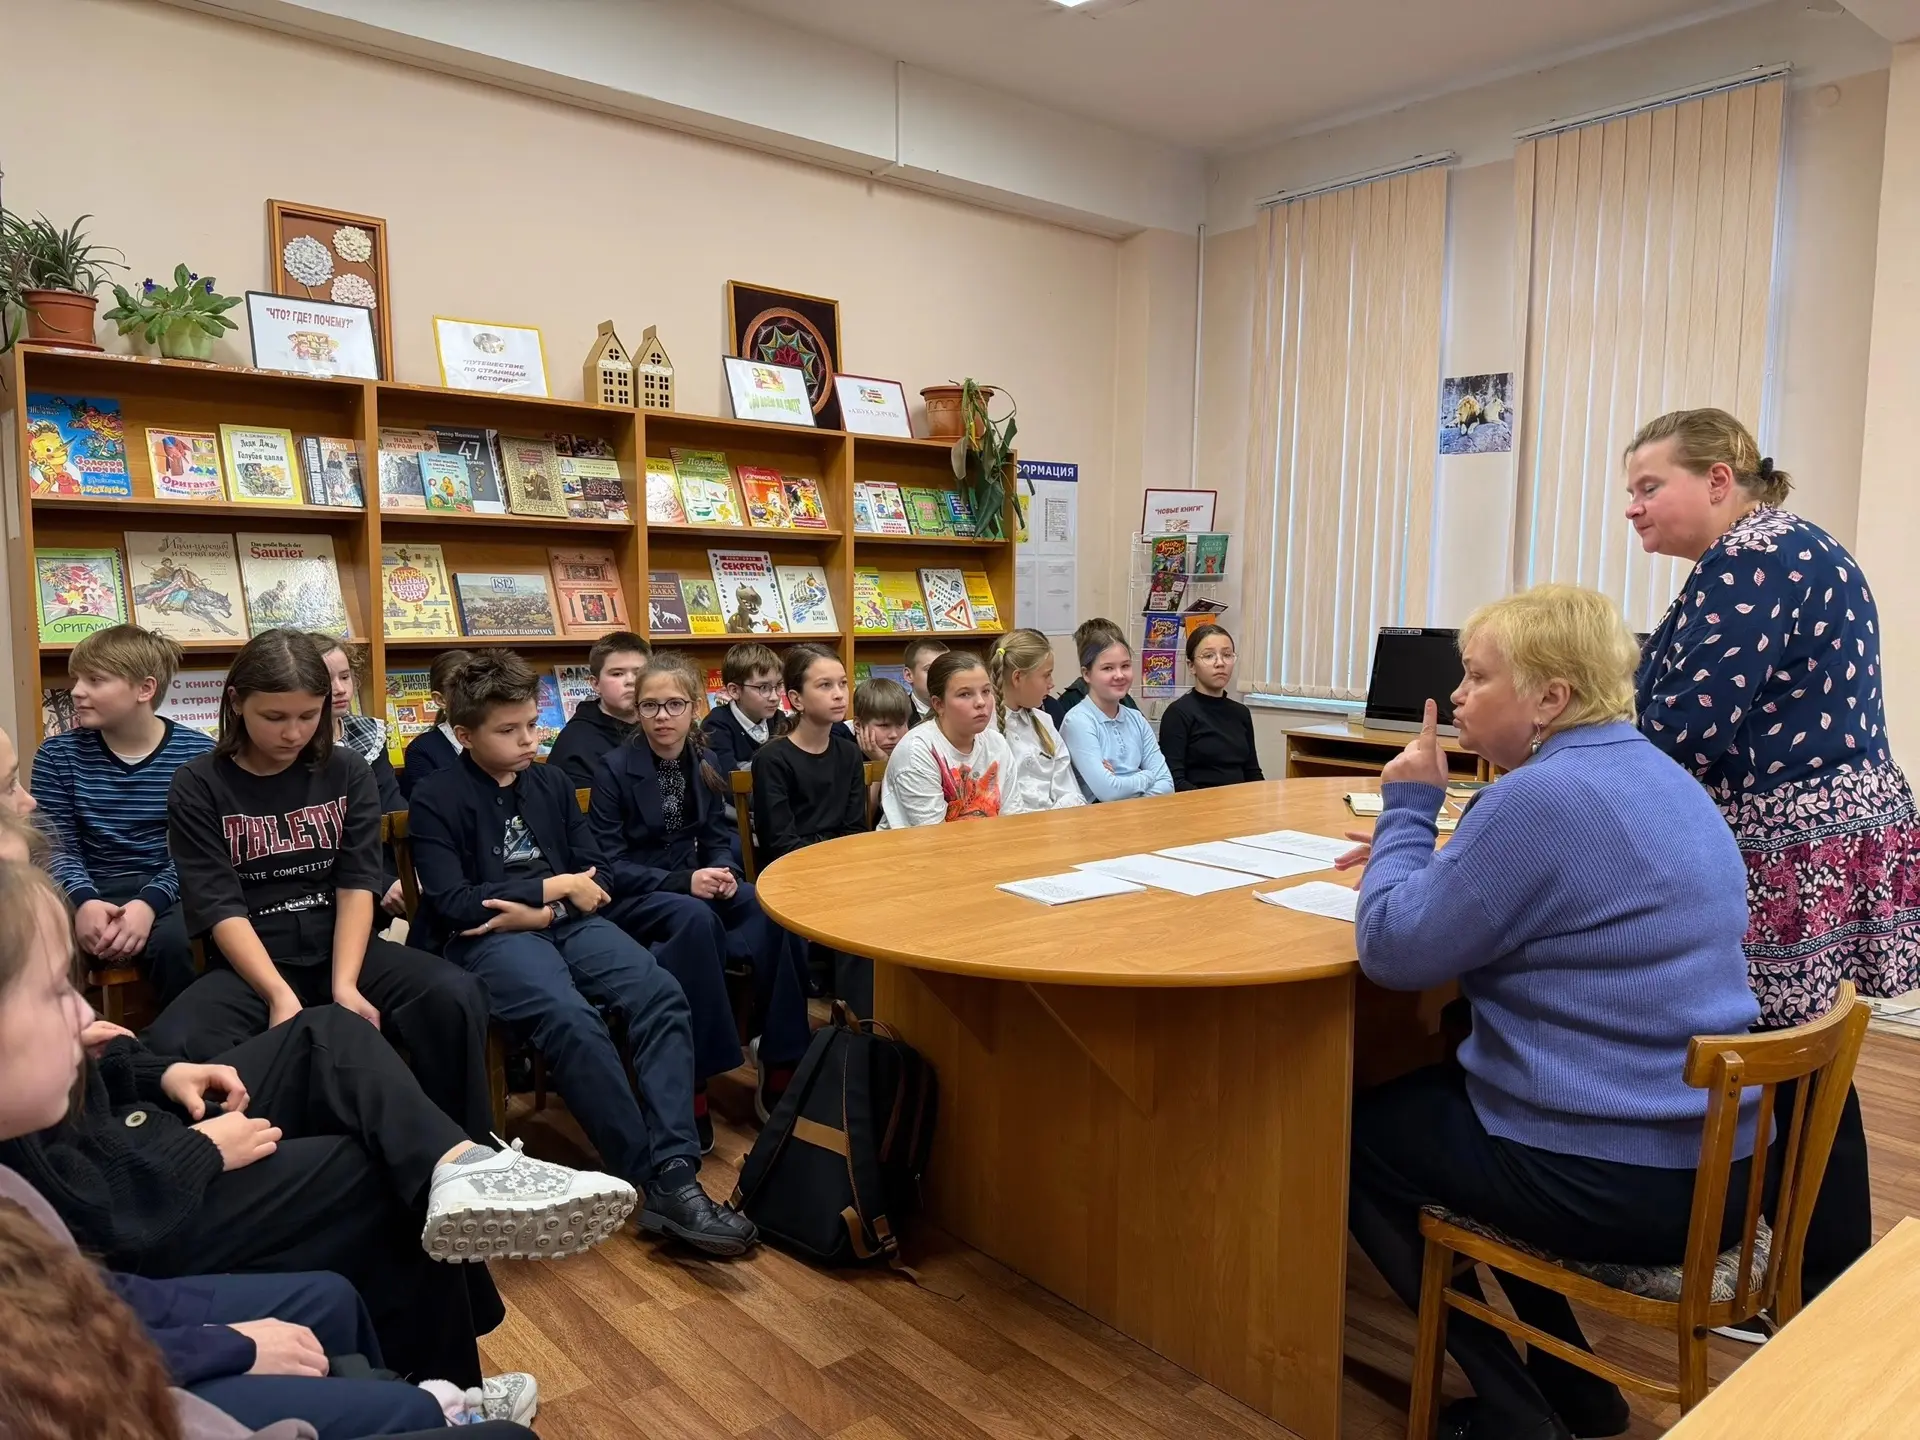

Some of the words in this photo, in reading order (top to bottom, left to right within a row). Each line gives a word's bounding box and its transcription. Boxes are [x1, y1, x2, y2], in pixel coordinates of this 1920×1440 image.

[266, 307, 290, 320] "ЧТО?
[292, 311, 312, 324] ГДЕ?
[313, 314, 354, 328] ПОЧЕМУ?"
[463, 360, 525, 369] "ПУТЕШЕСТВИЕ
[478, 368, 526, 377] СТРАНИЦАМ
[476, 375, 518, 383] ИСТОРИИ"
[458, 440, 481, 460] 47
[238, 451, 262, 460] Голубая
[712, 453, 723, 461] 50
[162, 476, 217, 488] Оригами
[1155, 507, 1179, 515] "НОВЫЕ
[250, 547, 304, 559] Saurier
[721, 562, 765, 571] СЕКРЕТЫ
[493, 579, 514, 589] 1812
[472, 627, 518, 636] БОРОДИНСКАЯ
[519, 628, 553, 636] ПАНОРАМА
